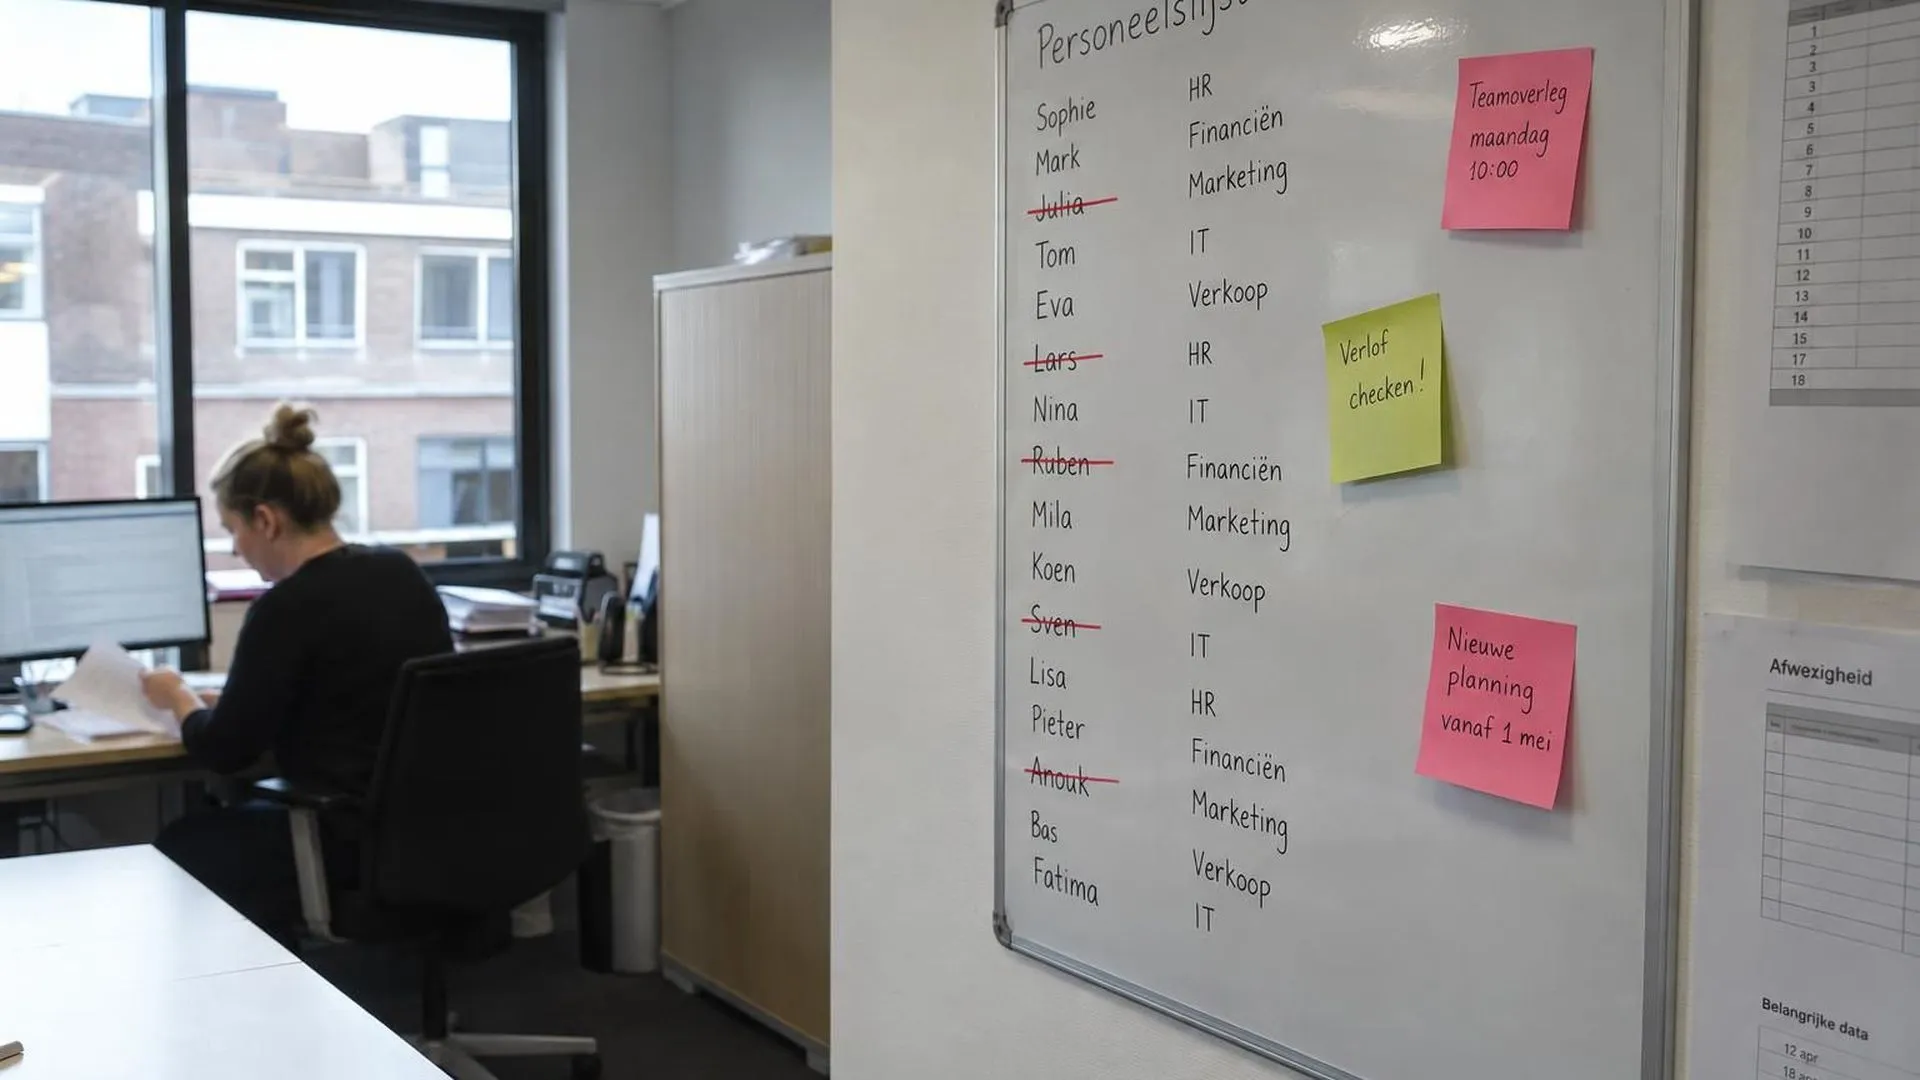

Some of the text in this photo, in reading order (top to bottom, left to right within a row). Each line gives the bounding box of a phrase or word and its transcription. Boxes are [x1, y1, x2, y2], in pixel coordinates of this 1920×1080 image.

[1038, 0, 1248, 68] Personeelslij
[1811, 25, 1817, 38] 1
[1809, 61, 1817, 73] 3
[1189, 74, 1213, 102] HR
[1469, 79, 1568, 115] Teamoverleg
[1808, 81, 1816, 93] 3
[1036, 97, 1097, 137] Sophie
[1807, 102, 1815, 113] 4
[1189, 105, 1283, 148] Financiën
[1470, 121, 1550, 158] maandag
[1806, 123, 1815, 135] 5
[1035, 143, 1081, 176] Mark
[1806, 144, 1814, 156] 6
[1189, 160, 1288, 199] Marketing
[1470, 160, 1519, 181] 10:00
[1805, 164, 1813, 176] 7
[1804, 185, 1812, 198] 8
[1036, 191, 1085, 222] Julia
[1804, 206, 1812, 218] 9
[1190, 228, 1210, 255] IT
[1797, 228, 1812, 240] 10
[1035, 240, 1076, 269] Tom
[1797, 249, 1810, 261] 11
[1795, 269, 1810, 282] 12
[1036, 290, 1075, 320] Eva
[1189, 278, 1269, 311] Verkoop
[1795, 290, 1809, 302] 13
[1793, 311, 1808, 323] 14
[1340, 329, 1389, 366] Verlof
[1793, 332, 1808, 345] 15
[1034, 344, 1077, 373] Lars
[1188, 341, 1213, 366] HR
[1792, 353, 1807, 366] 17
[1033, 395, 1079, 423] Nina
[1189, 398, 1209, 423] IT
[1032, 445, 1090, 477] Ruben
[1187, 453, 1282, 482] Financiën
[1032, 500, 1073, 530] Mila
[1187, 505, 1291, 552] Marketing
[1032, 551, 1076, 584] Koen
[1187, 569, 1266, 613] Verkoop
[1031, 604, 1075, 638] Sven
[1190, 633, 1210, 658] IT
[1448, 626, 1515, 660] Nieuwe
[1030, 657, 1067, 690] Lisa
[1770, 658, 1873, 686] Afwexigheid
[1191, 689, 1216, 717] HR
[1447, 664, 1534, 715] planning
[1032, 704, 1086, 740] Pieter
[1441, 714, 1553, 752] vanaf 1 mei
[1192, 738, 1286, 783] Financiën
[1030, 756, 1089, 798] Anouk
[1031, 810, 1058, 843] Bas
[1192, 789, 1288, 855] Marketing
[1034, 857, 1099, 906] Fatima
[1193, 848, 1271, 909] Verkoop
[1195, 902, 1215, 932] IT
[1762, 997, 1869, 1041] Belangrijke data
[1785, 1043, 1818, 1064] 12 apr
[1784, 1066, 1796, 1079] 18
